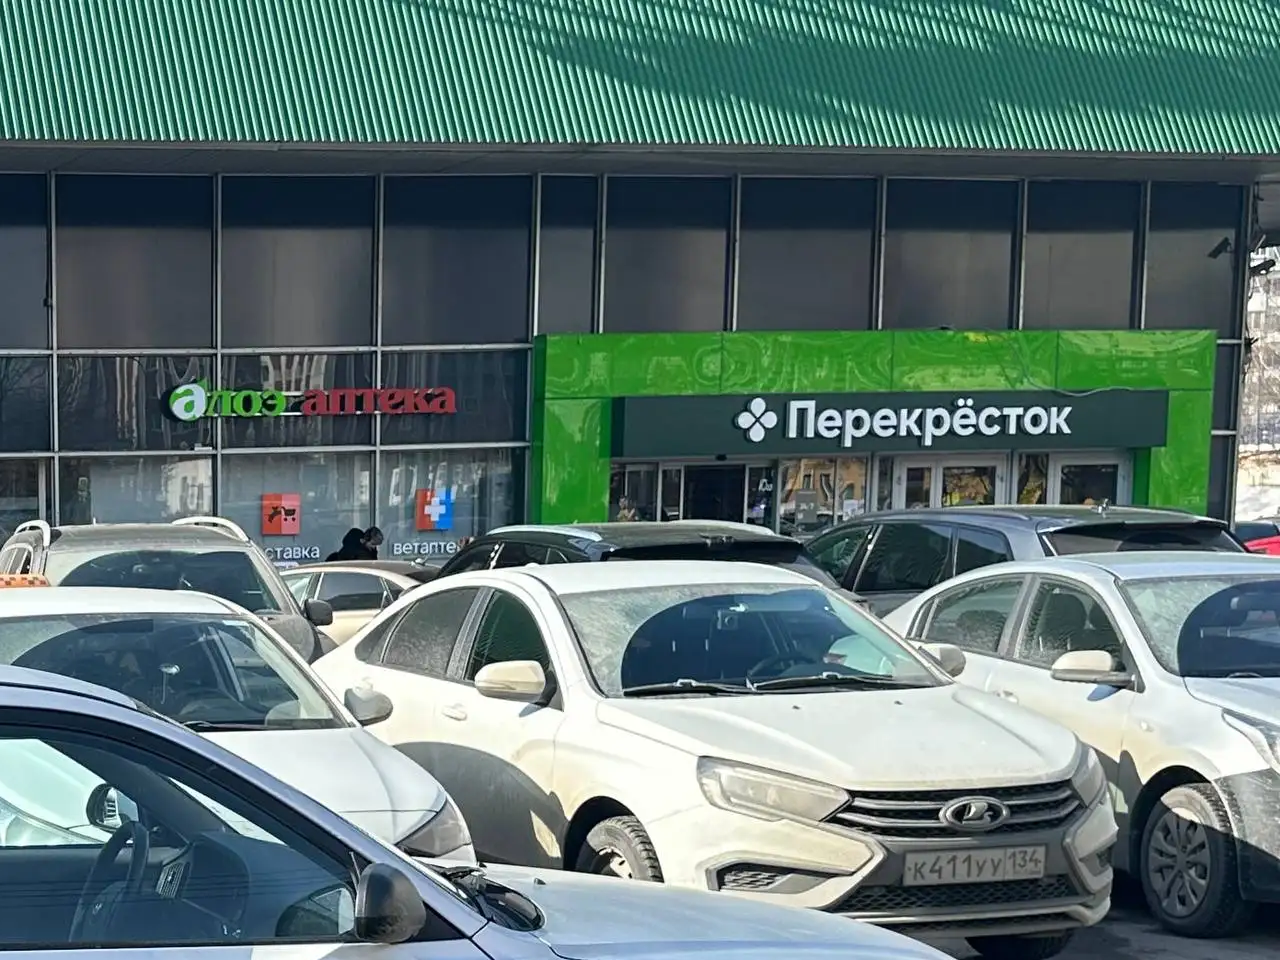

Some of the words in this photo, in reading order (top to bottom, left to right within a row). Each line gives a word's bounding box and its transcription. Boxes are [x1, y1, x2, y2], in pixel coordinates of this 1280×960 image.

[169, 378, 287, 422] алоэ
[300, 387, 457, 416] аптека
[787, 397, 1073, 448] Перекрёсток
[264, 545, 320, 560] ставка
[393, 541, 458, 556] ветапте
[1008, 849, 1041, 870] 134
